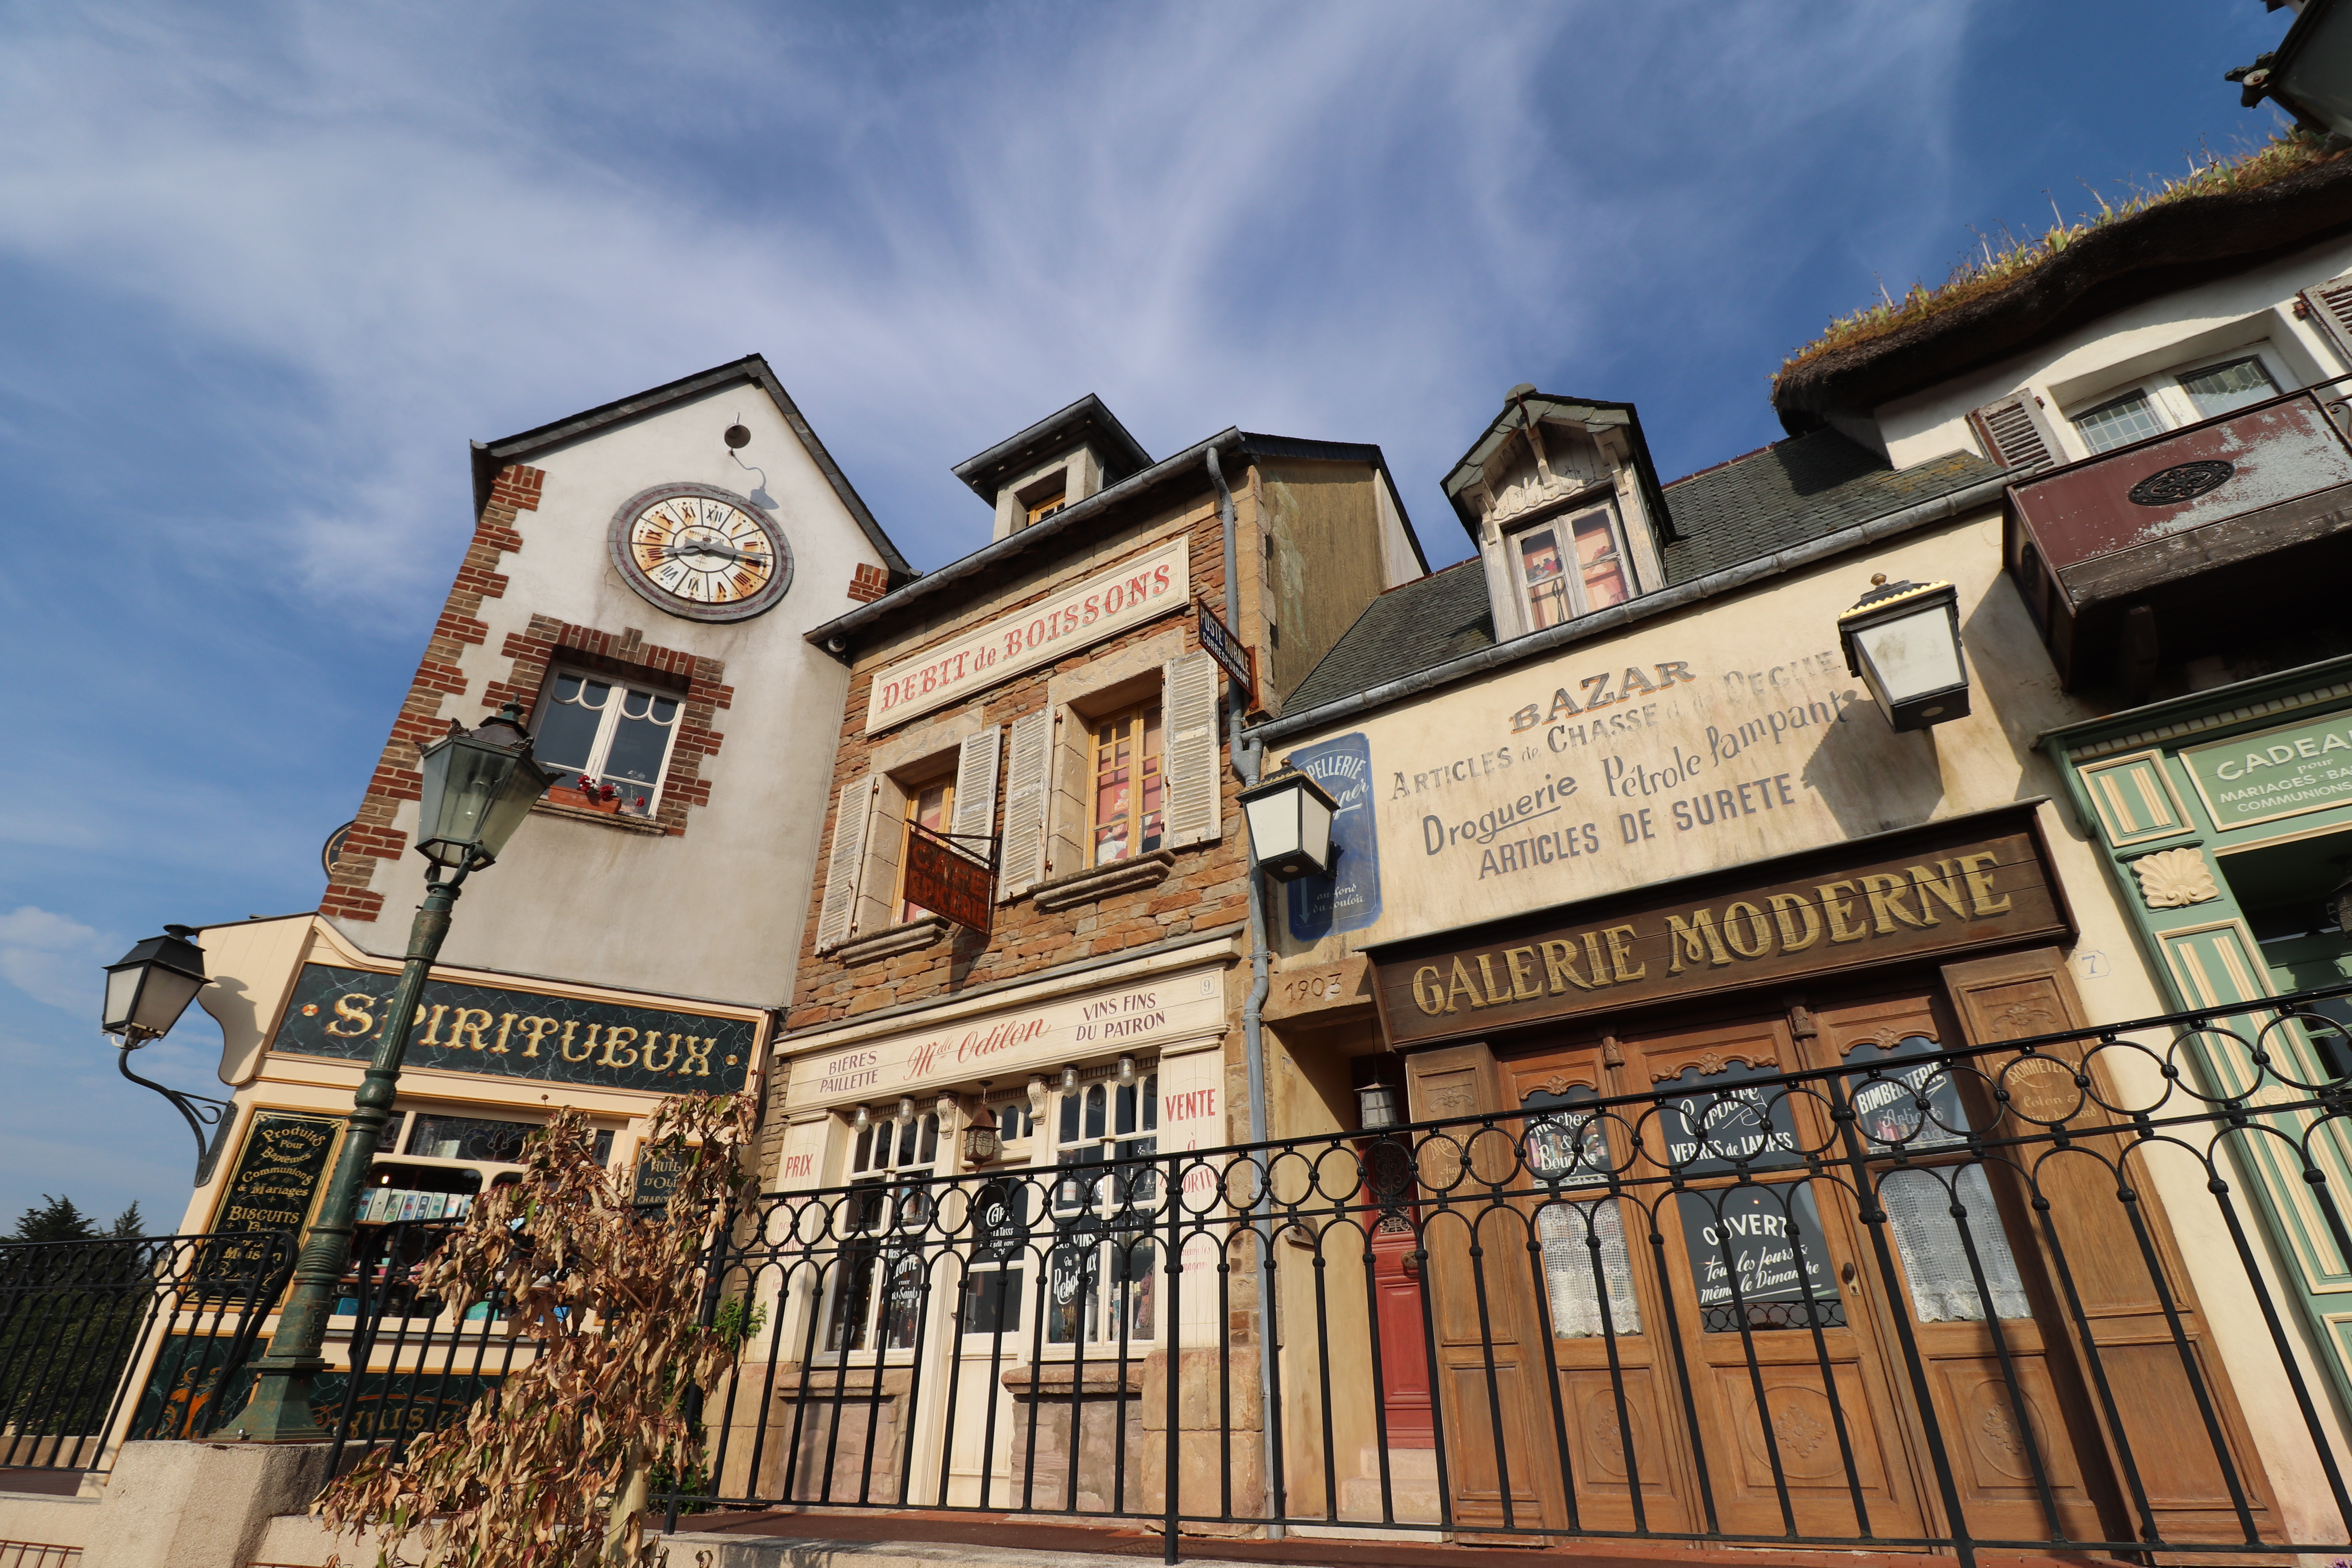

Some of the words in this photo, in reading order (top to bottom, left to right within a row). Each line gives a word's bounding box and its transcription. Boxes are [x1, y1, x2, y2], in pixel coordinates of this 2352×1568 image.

[706, 508, 722, 522] XII
[881, 651, 969, 712] DEBIT
[974, 646, 996, 672] de
[1004, 564, 1171, 660] BOISSONS
[1200, 606, 1223, 646] POSTE
[1225, 633, 1250, 676] RURALE
[1203, 632, 1249, 687] CORRESPONDANT
[1509, 661, 1696, 735] BAZAR
[1389, 746, 1513, 801] ARTICLES
[1521, 746, 1541, 762] de
[1547, 702, 1657, 753] CHASSE
[1423, 773, 1578, 856] Droguerie
[1601, 746, 1701, 797] Pétrole
[1705, 690, 1849, 768] lampant
[2220, 775, 2316, 803] MARIAGES
[2237, 781, 2352, 812] COMMUNIONS
[1477, 822, 1600, 881] ARTICLES
[1619, 808, 1655, 846] DE
[1672, 773, 1796, 832] SURETE
[909, 869, 987, 928] EPICERIE
[1313, 904, 1325, 913] du
[1329, 894, 1366, 909] couloir
[1333, 883, 1357, 899] fond
[1412, 924, 1646, 1016] GALERIE
[1664, 851, 2011, 974] MODERNE
[2082, 955, 2098, 974] 7
[1204, 980, 1210, 992] 9
[1285, 973, 1342, 1003] 1903
[1083, 992, 1117, 1022] VINS
[1123, 992, 1156, 1012] FINS
[1076, 1024, 1100, 1041] DU
[1104, 1011, 1165, 1038] PATRON
[957, 1018, 1051, 1065] Odilon
[820, 1069, 879, 1093] PAILLETTE
[1857, 1062, 1944, 1114] BIMBELOTERIE
[1165, 1088, 1216, 1122] VENTE
[2023, 1096, 2062, 1107] Coton
[1882, 1108, 1943, 1127] Artices
[262, 1126, 326, 1146] Produits
[279, 1140, 305, 1149] Pour
[1428, 1134, 1479, 1160] MERCERE
[261, 1146, 312, 1163] Baptêmes
[1670, 1140, 1724, 1163] VERRES
[1726, 1143, 1740, 1156] de
[242, 1167, 314, 1185] Communions
[655, 1161, 681, 1172] HUIL
[784, 1154, 814, 1179] PRIX
[250, 1183, 309, 1197] Mariages
[644, 1177, 679, 1189] D'OLI
[637, 1196, 669, 1204] CHARC
[227, 1205, 300, 1224] BISCUITS
[1000, 1227, 1014, 1236] TASSE
[1704, 1255, 1728, 1282] tou
[1736, 1250, 1755, 1272] les
[1740, 1274, 1753, 1292] le
[1756, 1261, 1820, 1289] Dimanhe
[899, 1287, 918, 1299] Saints
